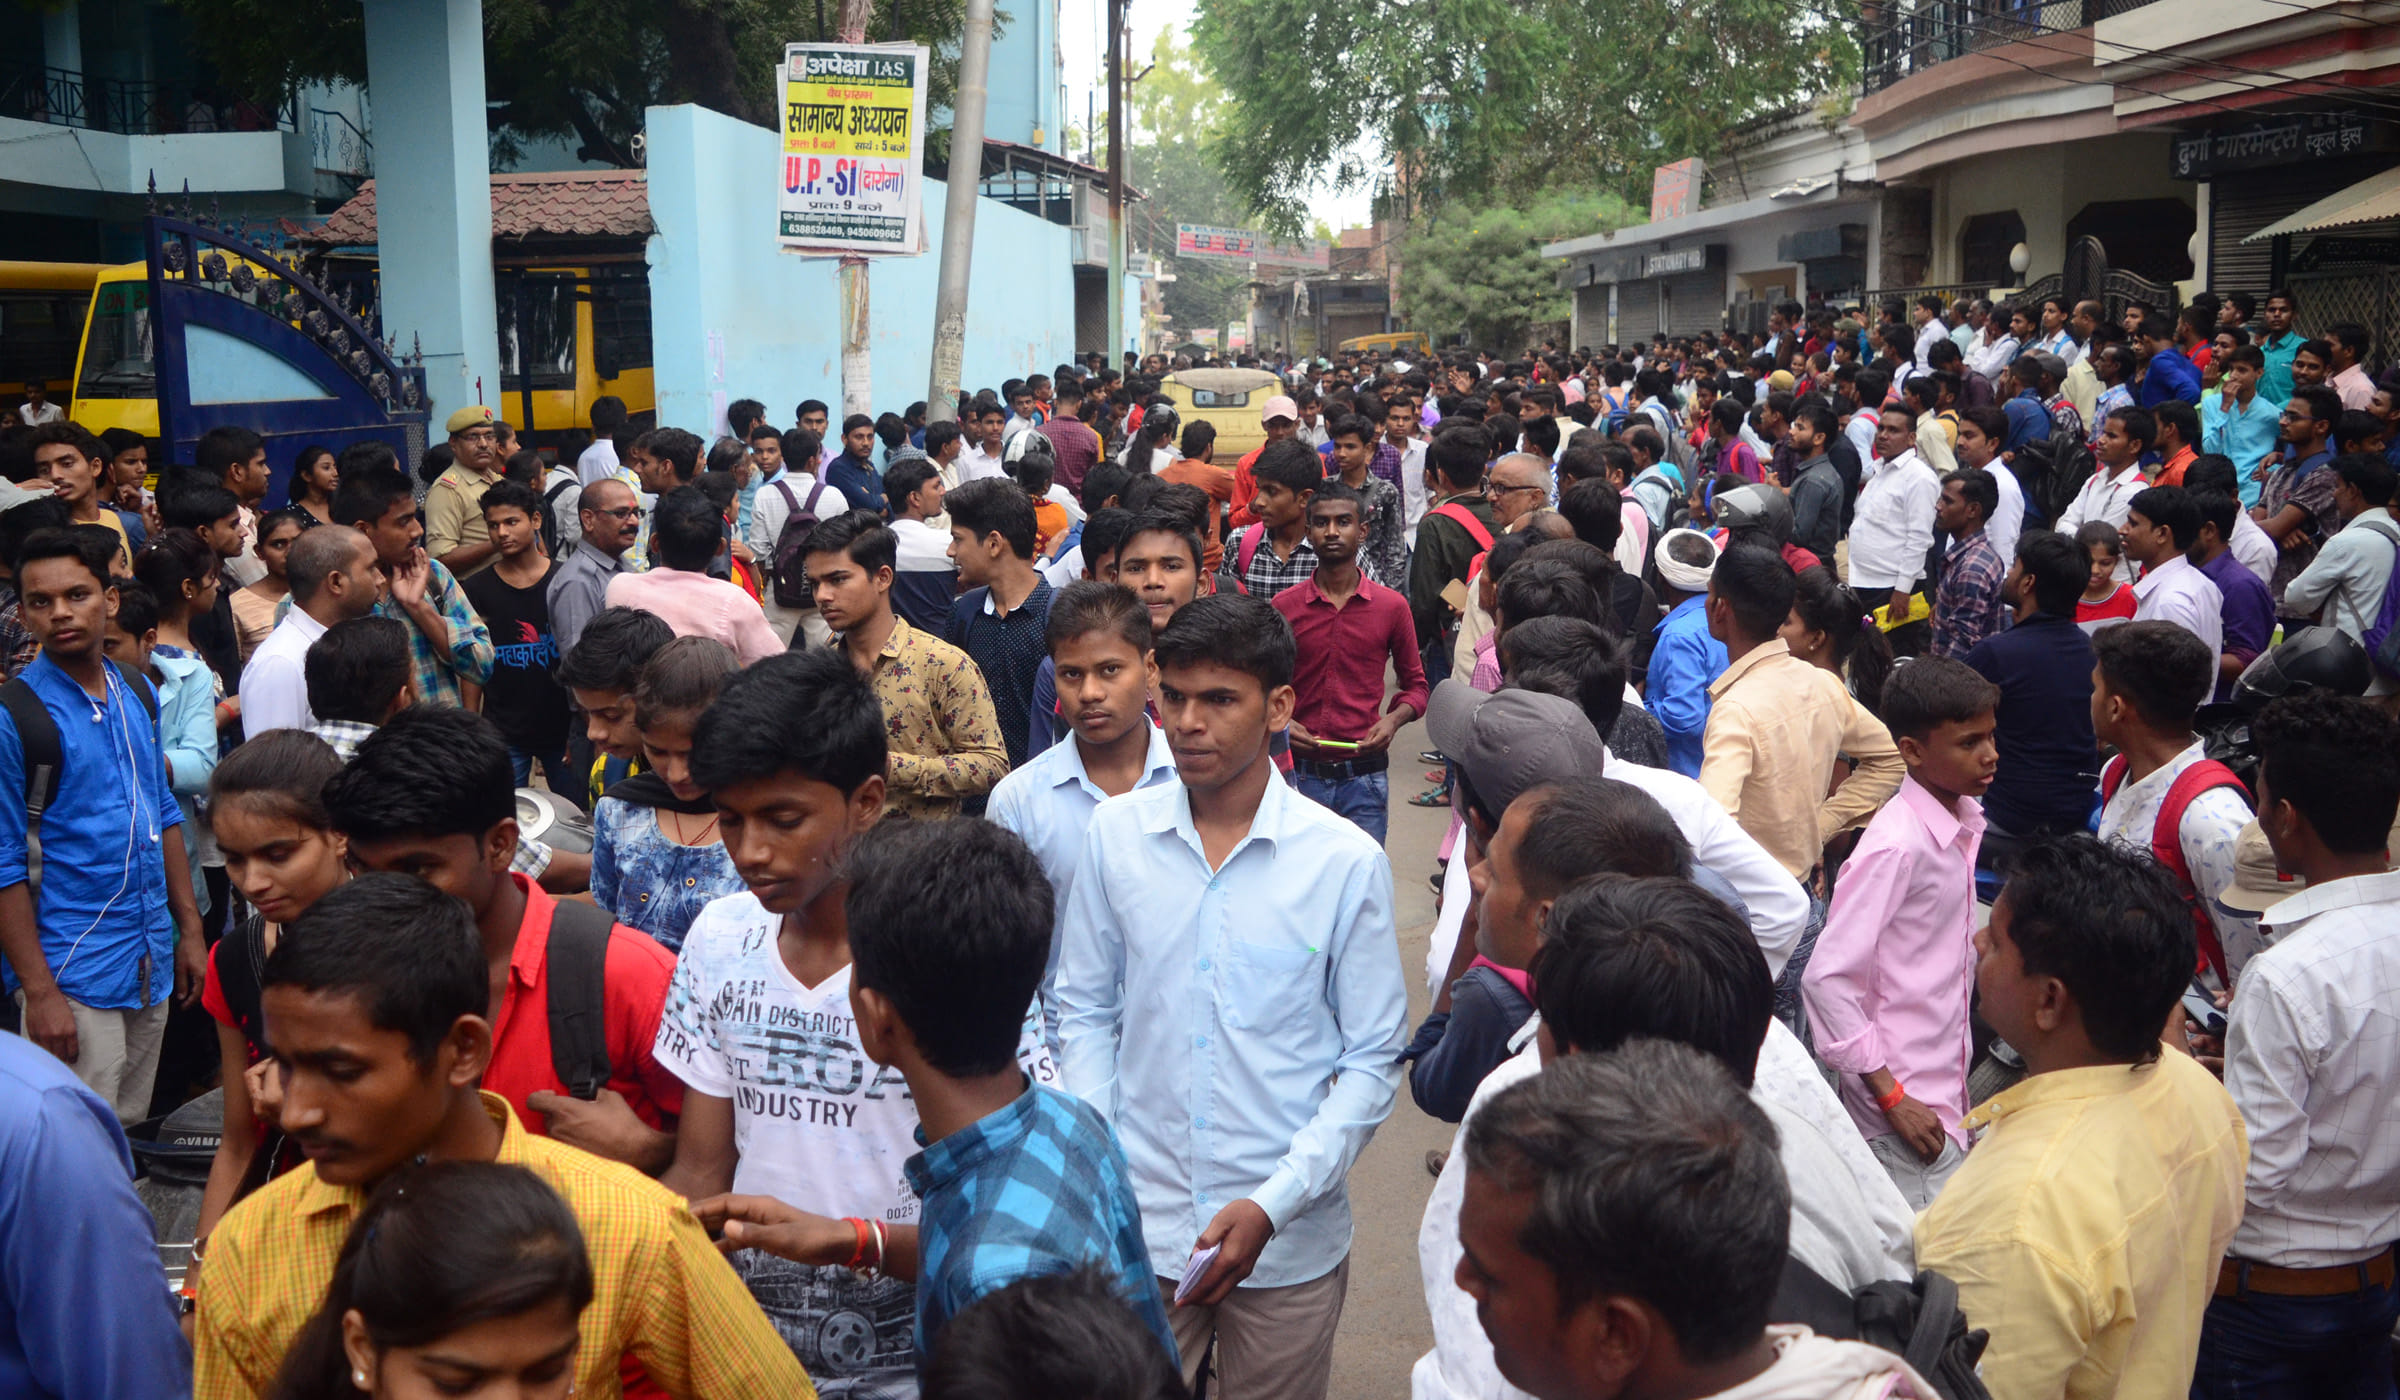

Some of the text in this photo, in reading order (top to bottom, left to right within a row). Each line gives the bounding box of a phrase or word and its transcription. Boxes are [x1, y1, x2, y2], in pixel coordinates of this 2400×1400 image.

[807, 53, 905, 77] अपेक्षा IAS
[788, 102, 909, 137] सामान्य अध्ययन
[812, 137, 819, 150] 8
[881, 139, 888, 152] 5
[2178, 129, 2212, 175] दुर्गा
[2305, 130, 2338, 157] स्कूल
[844, 199, 852, 211] 9
[857, 202, 883, 213] बजे
[769, 1006, 855, 1037] DISTRICT
[736, 1086, 858, 1127] INDUSTRY
